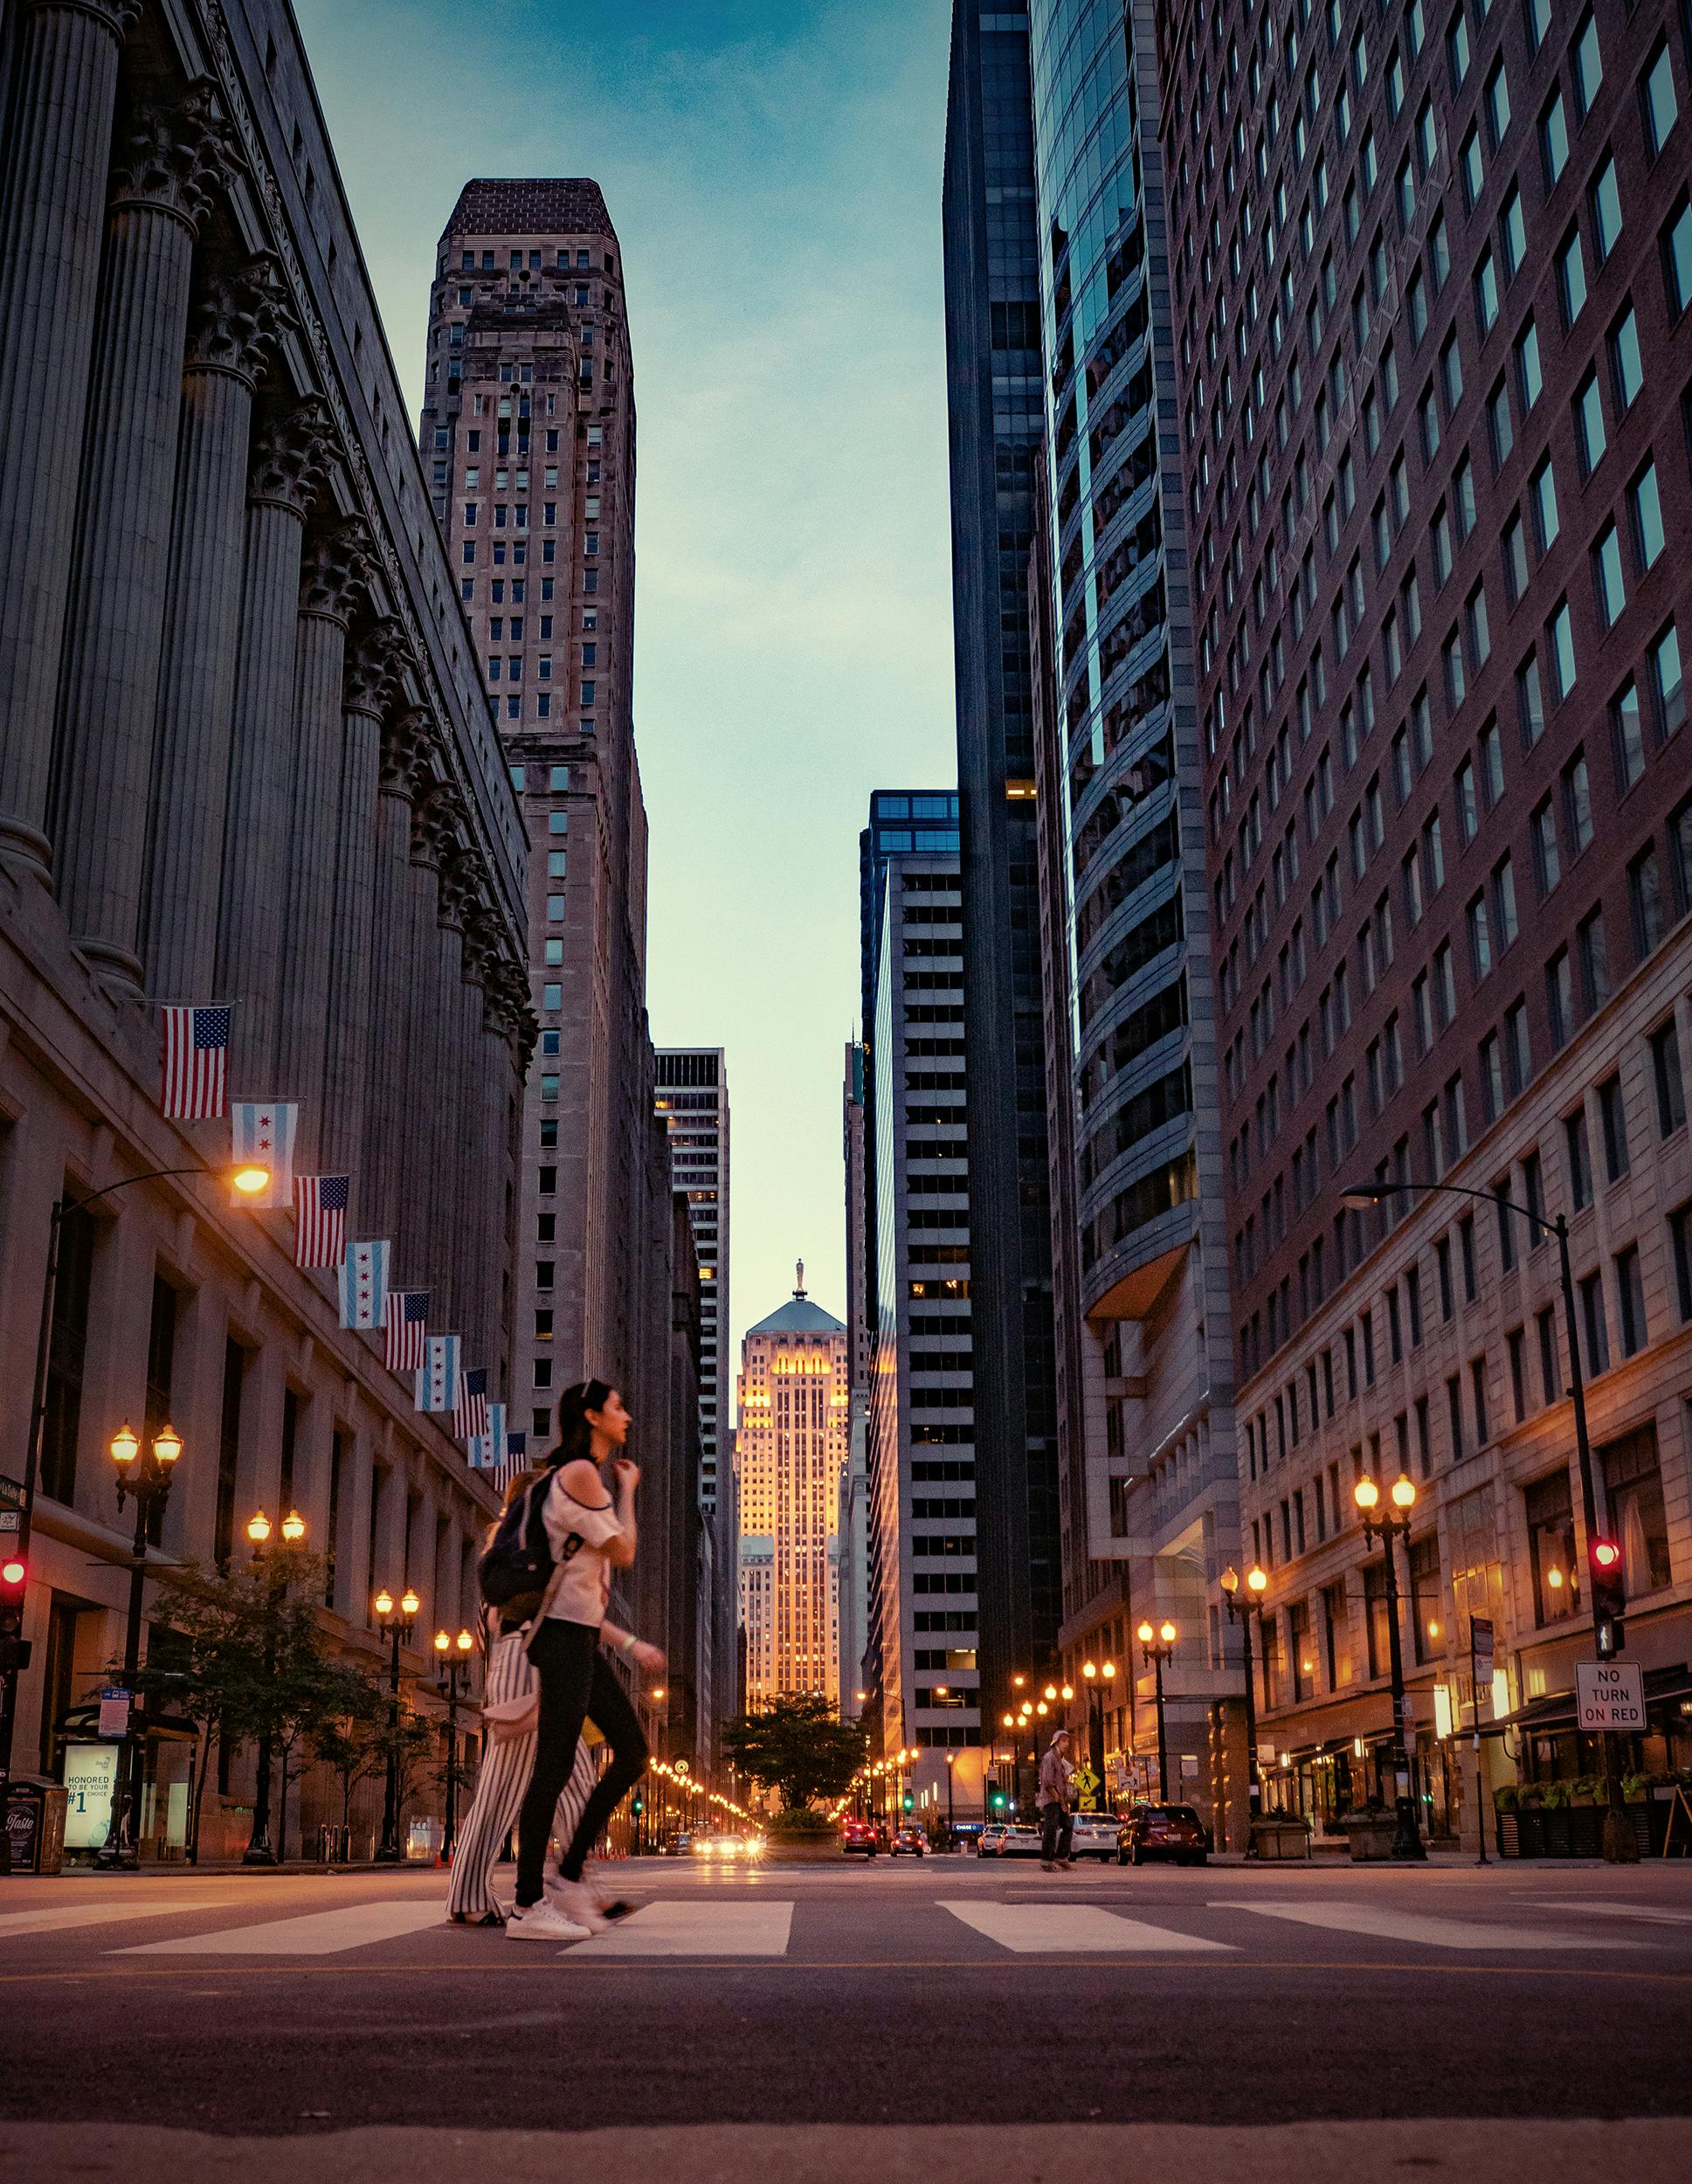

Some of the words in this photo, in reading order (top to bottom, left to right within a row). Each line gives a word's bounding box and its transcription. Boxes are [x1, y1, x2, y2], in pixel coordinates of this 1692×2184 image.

[1598, 1670, 1619, 1683] NO
[1592, 1690, 1629, 1702] TURN
[1585, 1708, 1606, 1721] ON
[1612, 1708, 1639, 1721] RED
[67, 1792, 86, 1813] #1
[5, 1813, 34, 1831] Taste
